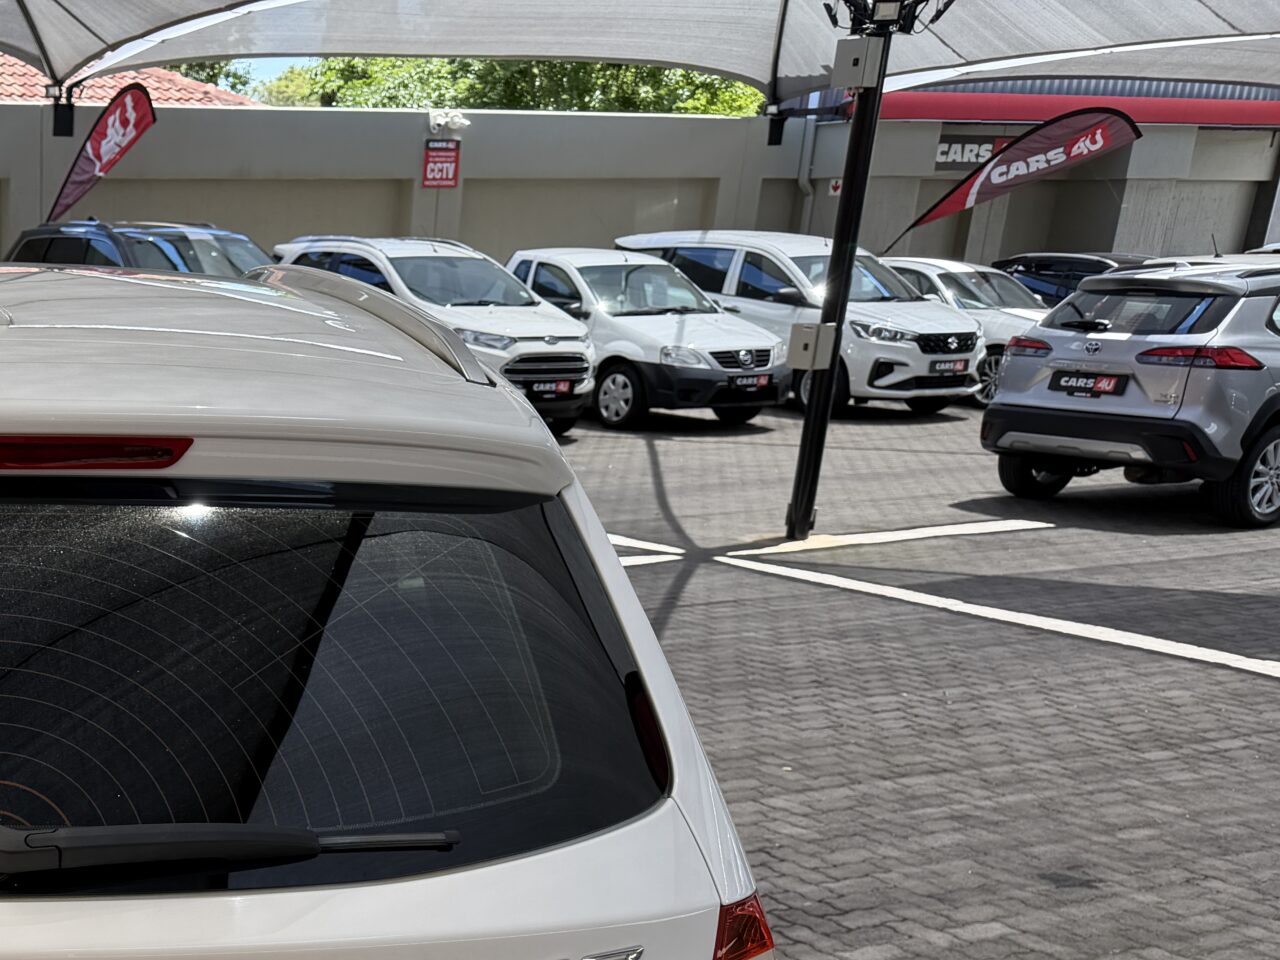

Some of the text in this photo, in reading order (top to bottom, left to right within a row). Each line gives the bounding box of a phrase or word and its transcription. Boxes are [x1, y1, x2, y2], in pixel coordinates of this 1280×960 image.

[936, 143, 993, 163] CARS
[990, 128, 1104, 184] CARS 4U
[427, 162, 456, 179] CCTV
[1060, 376, 1115, 391] CARS 4U
